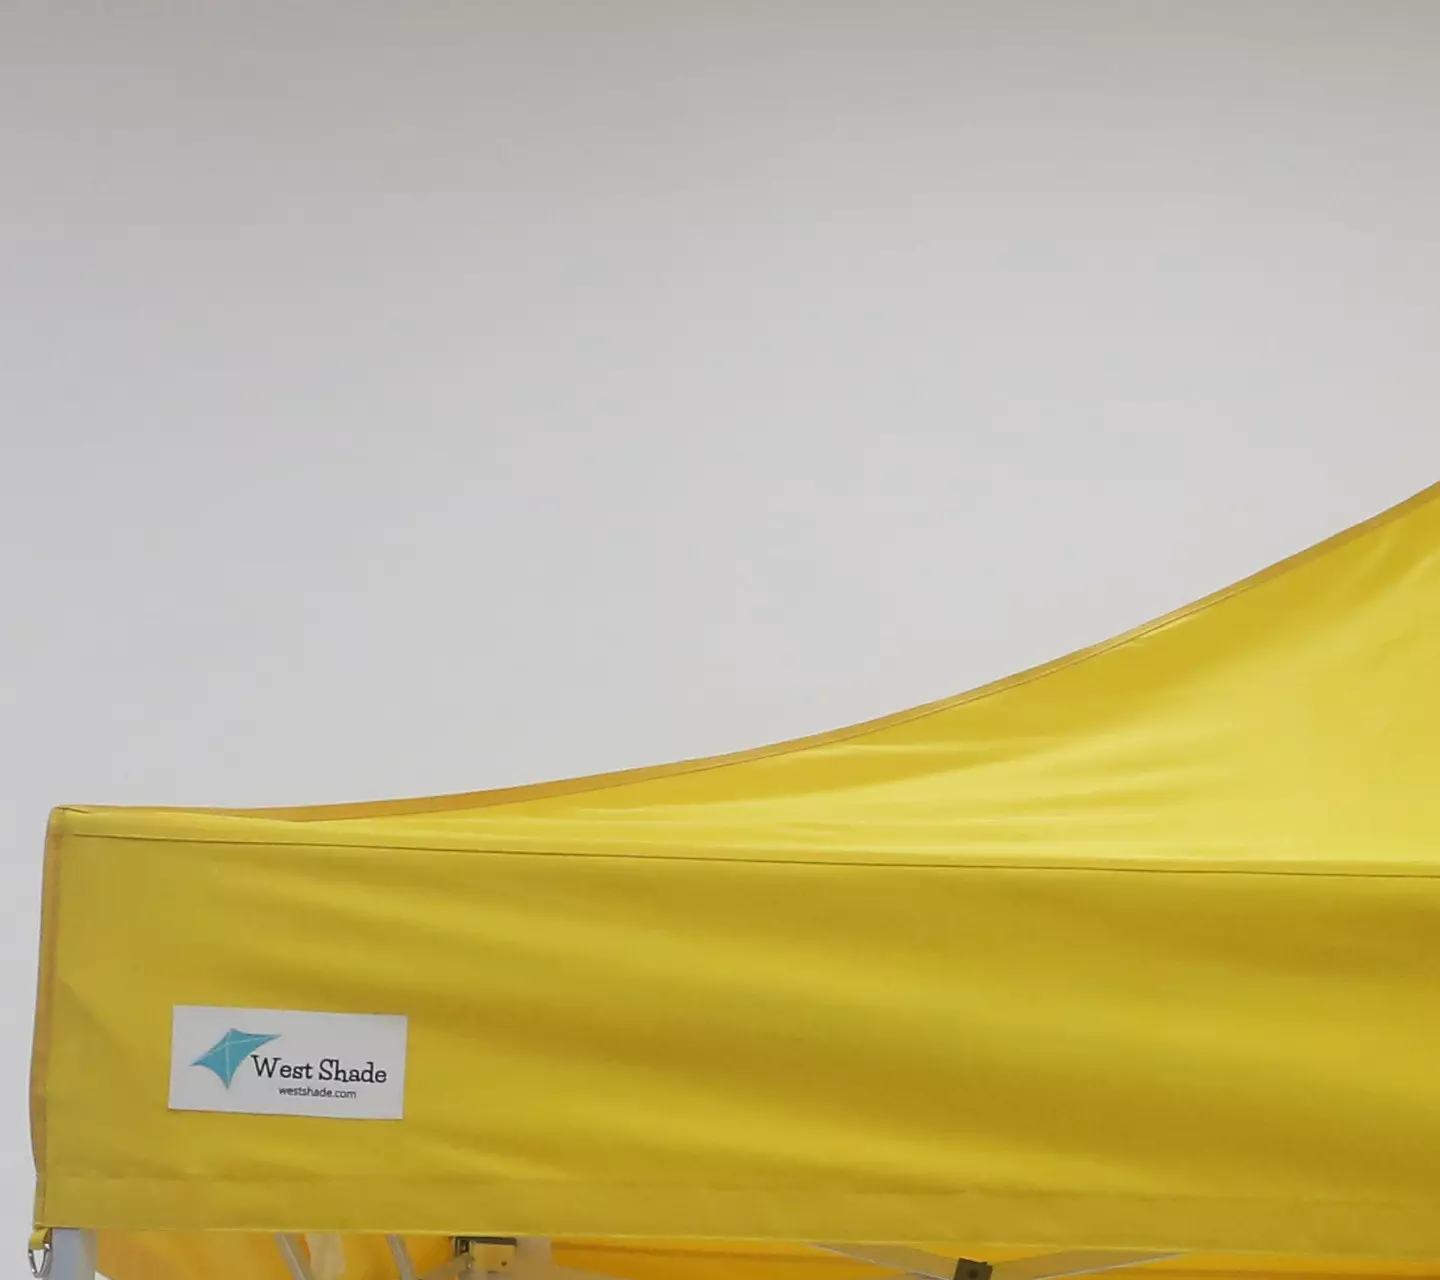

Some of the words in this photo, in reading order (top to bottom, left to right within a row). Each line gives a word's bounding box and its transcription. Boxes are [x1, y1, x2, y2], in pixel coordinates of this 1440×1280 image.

[251, 1054, 313, 1079] West
[318, 1058, 387, 1083] Shade
[278, 1086, 357, 1099] westshade.com
